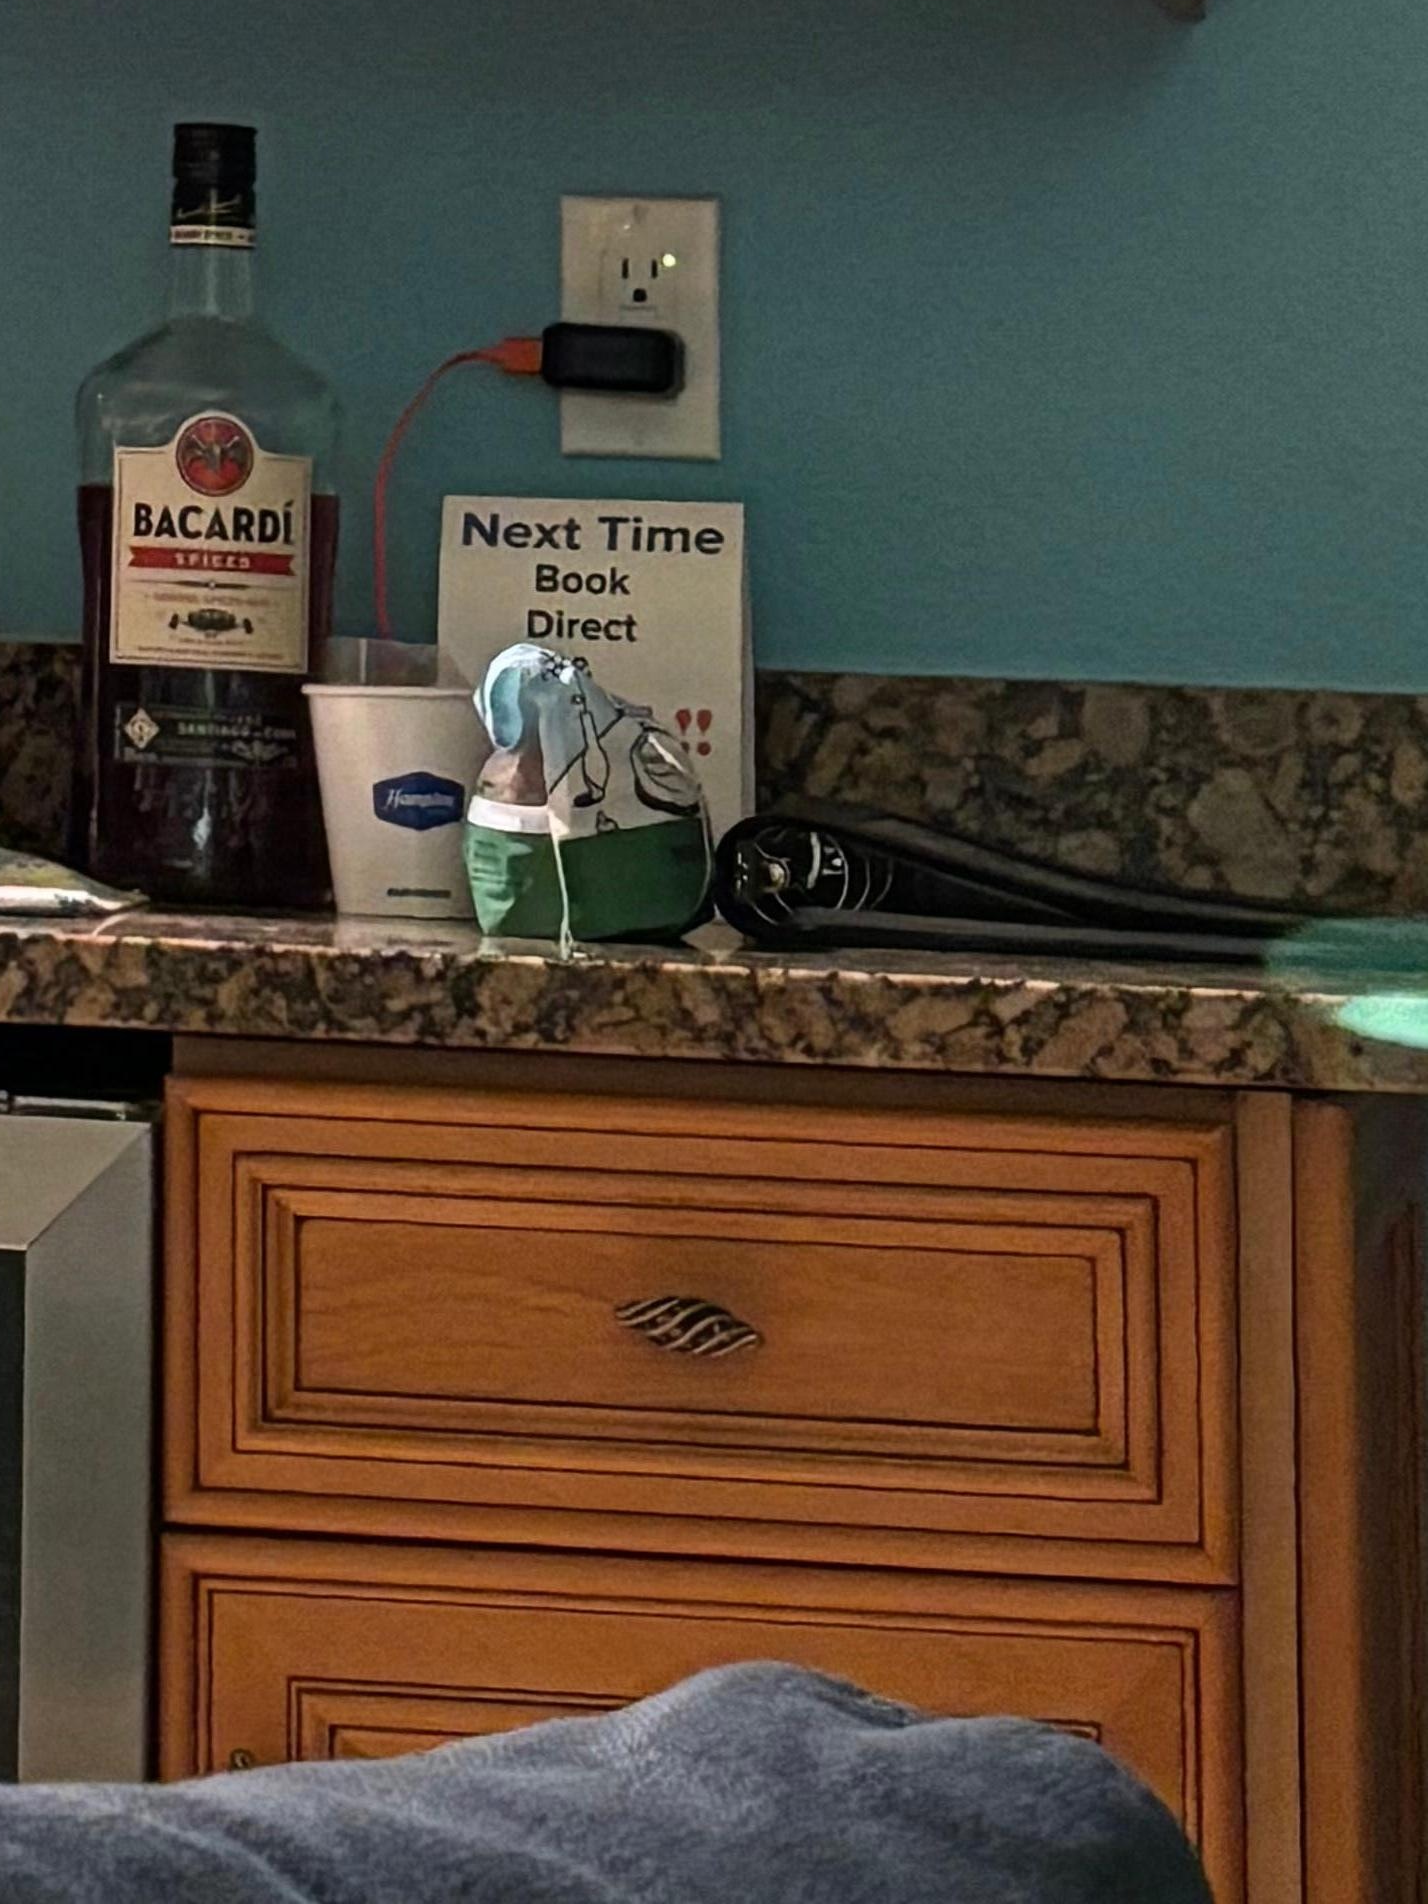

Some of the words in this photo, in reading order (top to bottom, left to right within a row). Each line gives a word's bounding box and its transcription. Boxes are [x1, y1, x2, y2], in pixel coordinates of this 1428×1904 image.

[133, 500, 295, 545] BACARDÍ
[461, 512, 581, 550] Next
[598, 516, 725, 554] Time
[535, 563, 631, 596] Book
[527, 609, 637, 642] Direct
